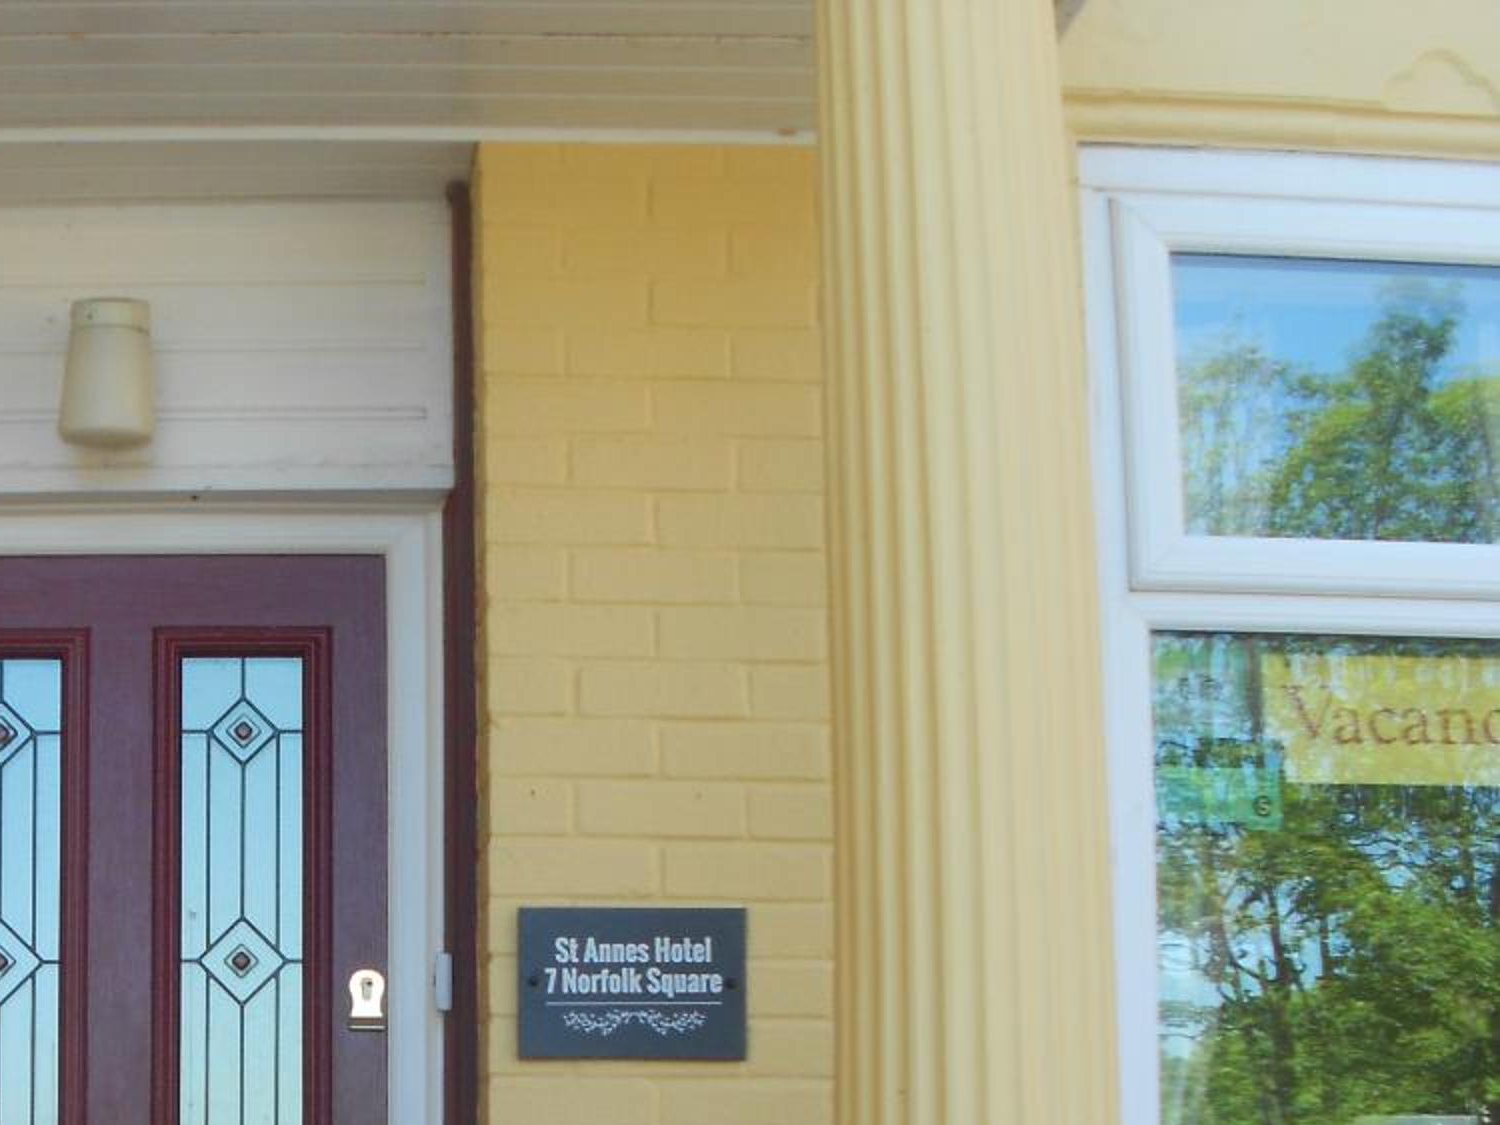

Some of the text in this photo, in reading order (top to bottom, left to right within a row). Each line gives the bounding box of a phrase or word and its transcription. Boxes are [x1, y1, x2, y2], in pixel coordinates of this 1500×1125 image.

[555, 936, 712, 963] St Annes Hotel
[544, 967, 724, 998] 7 Norfolk Square
